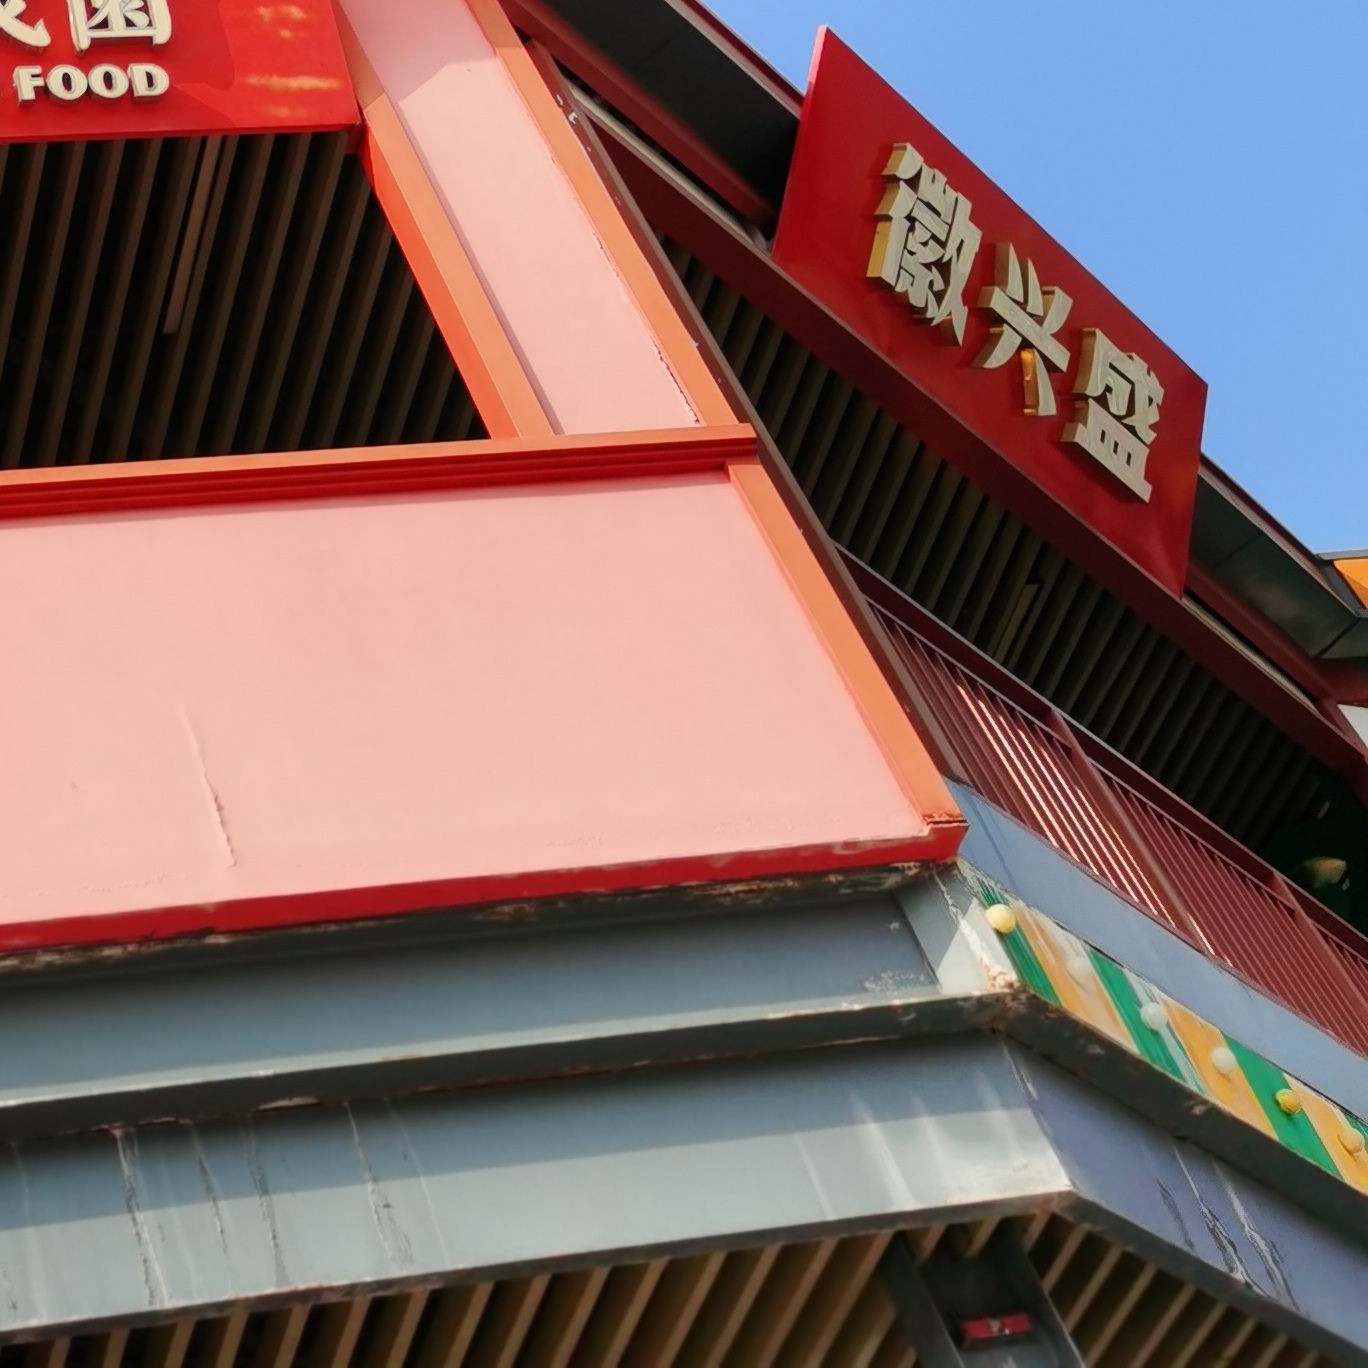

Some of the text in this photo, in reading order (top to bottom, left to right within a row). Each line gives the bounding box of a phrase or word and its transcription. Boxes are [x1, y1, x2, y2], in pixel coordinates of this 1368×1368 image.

[15, 62, 171, 103] FOOD
[868, 142, 1165, 504] 徽兴盛
